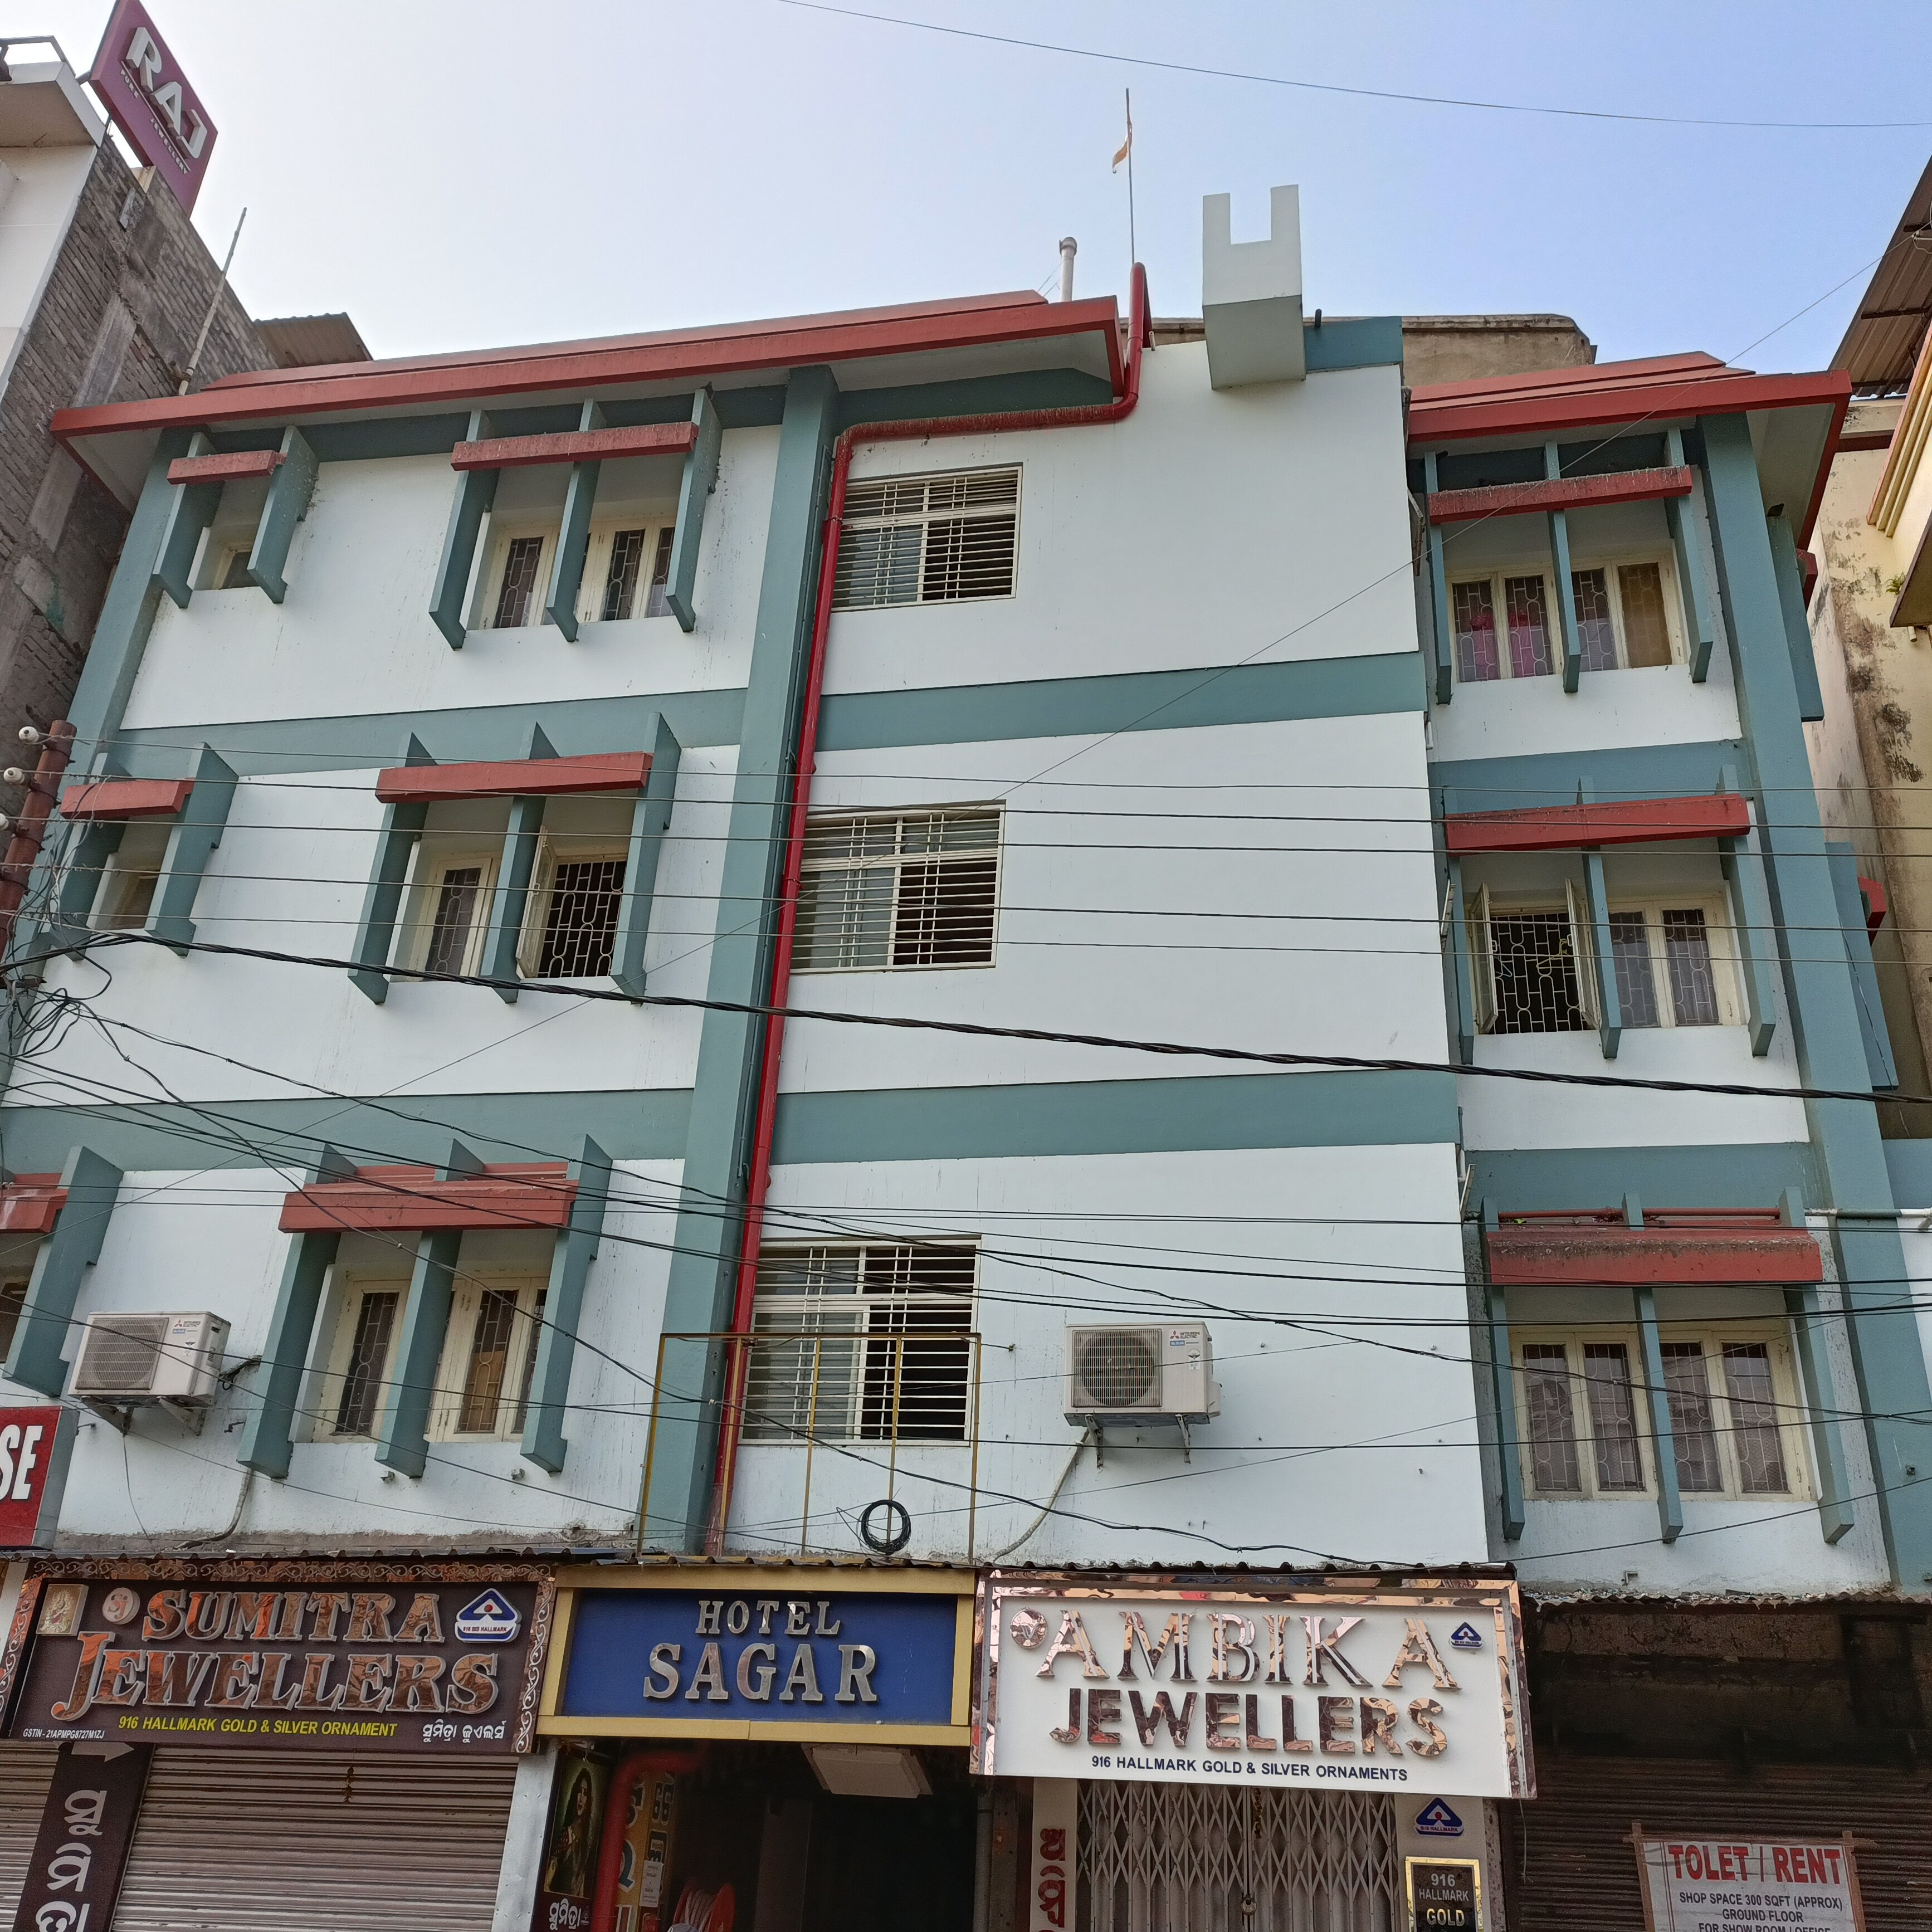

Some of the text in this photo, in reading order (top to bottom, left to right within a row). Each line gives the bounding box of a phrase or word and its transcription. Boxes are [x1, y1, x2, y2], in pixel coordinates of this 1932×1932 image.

[126, 27, 208, 159] RAJ
[143, 1589, 445, 1643] SUMITRA
[695, 1600, 841, 1636] HOTEL
[1035, 1609, 1463, 1690] AMBIKA
[51, 1631, 499, 1721] JEWELLERS
[643, 1642, 878, 1702] SAGAR
[23, 1729, 43, 1738] GSTIN
[118, 1716, 398, 1736] 916 HALLMARK GOLD & SILVER ORNAMENT
[423, 1719, 457, 1743] ସୁମିତ୍ରା
[1048, 1687, 1449, 1757] JEWELLERS
[1091, 1755, 1408, 1781] 916 HALLMARK GOLD & SILVER ORNAMENTS
[1668, 1845, 1749, 1881] TOLET
[1772, 1846, 1841, 1885] RENT
[1431, 1873, 1456, 1887] 916
[1418, 1888, 1470, 1902] HALLMARK
[1679, 1892, 1843, 1911] SHOP SPACE 300 SQFT (APPROX)
[1426, 1908, 1465, 1926] GOLD
[1699, 1923, 1719, 1932] FOR
[1722, 1924, 1753, 1932] SHOW
[1722, 1909, 1804, 1923] GROUND FLOOR
